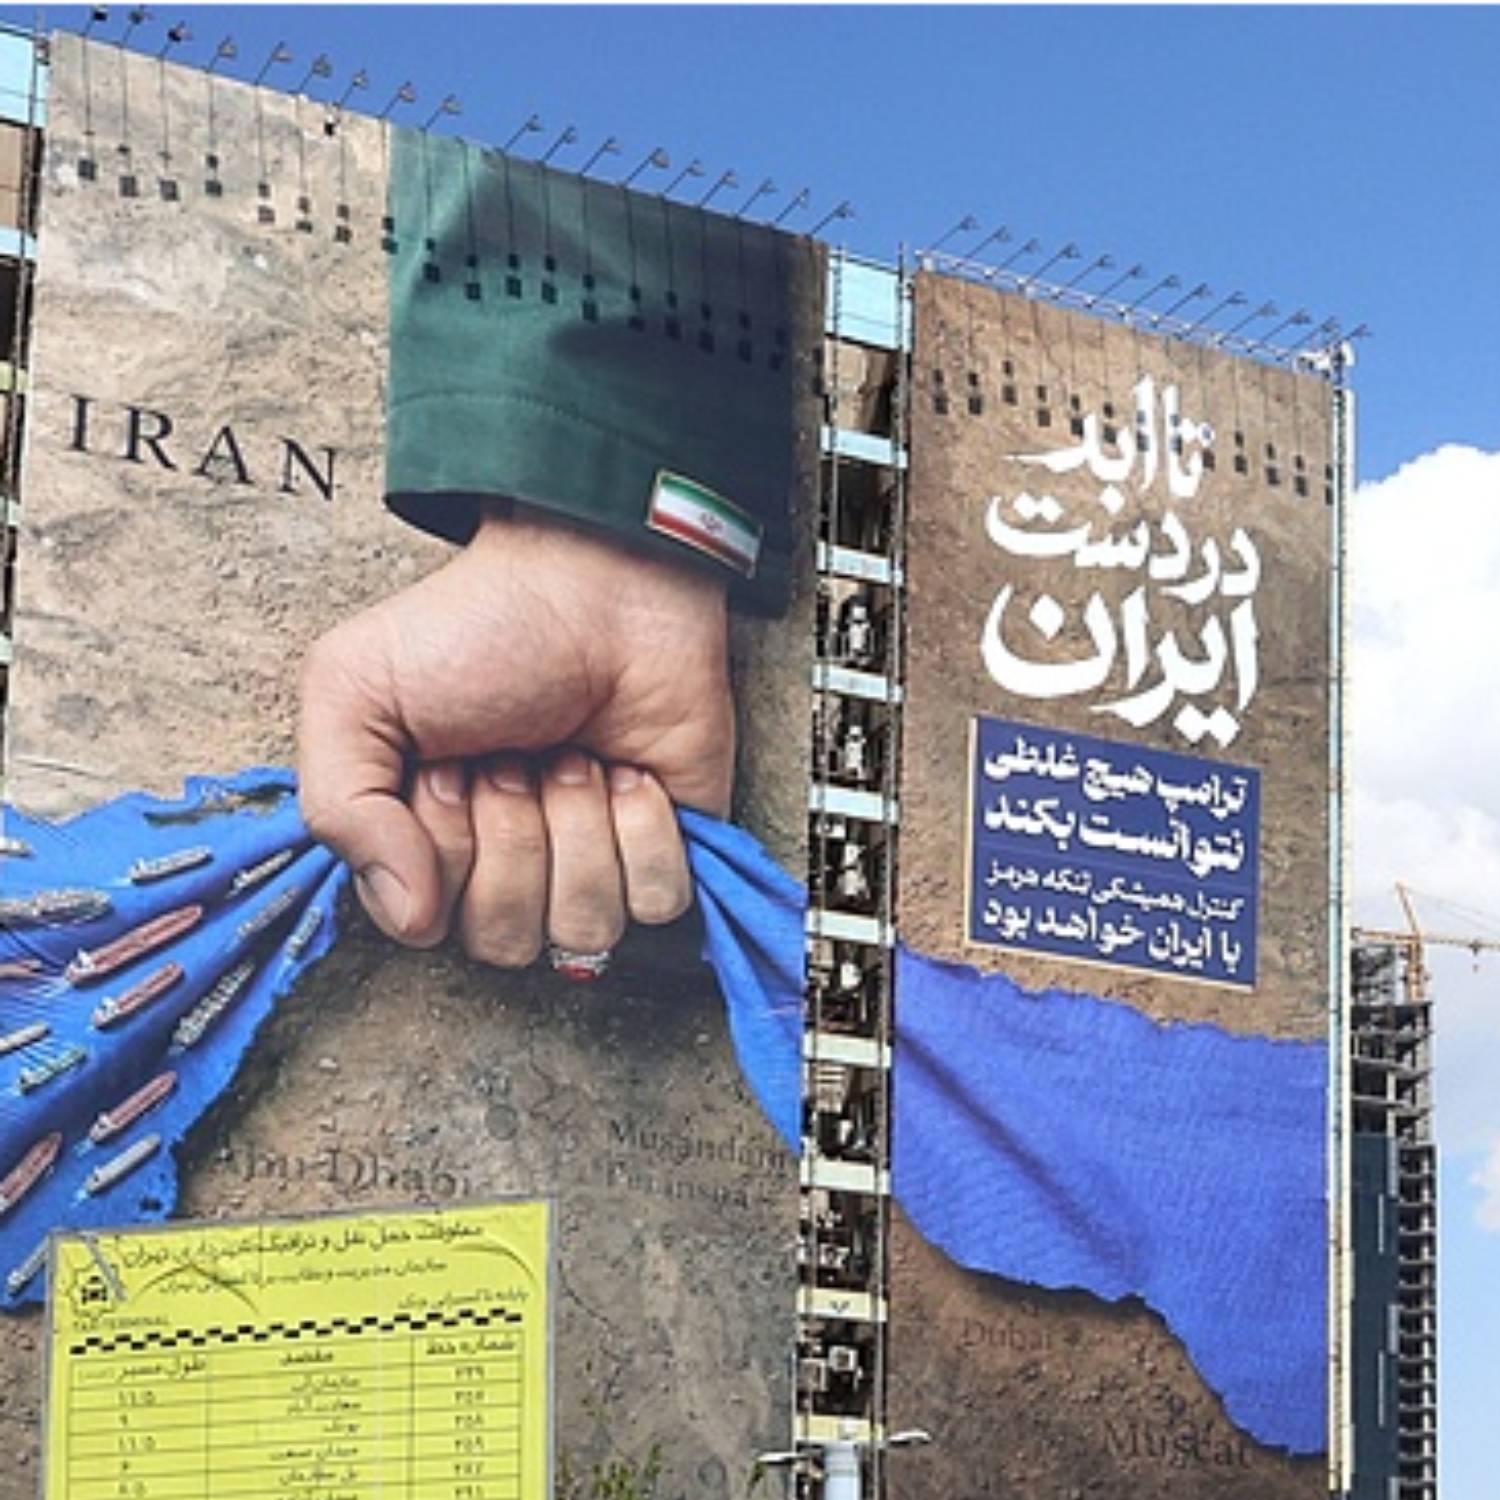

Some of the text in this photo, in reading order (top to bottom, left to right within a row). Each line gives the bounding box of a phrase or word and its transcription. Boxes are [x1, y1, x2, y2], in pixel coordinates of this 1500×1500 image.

[70, 393, 338, 501] IRAN
[1004, 372, 1155, 508] ابد
[983, 491, 1261, 599] در دست
[980, 583, 1261, 749] ایران
[983, 735, 1249, 821] ترامپ هیچ غلطی
[983, 794, 1246, 878] نتوانست بکند
[982, 898, 1242, 973] با ایران خواهد بود
[984, 858, 1246, 921] کنترل همیشگی تنگه هرمز
